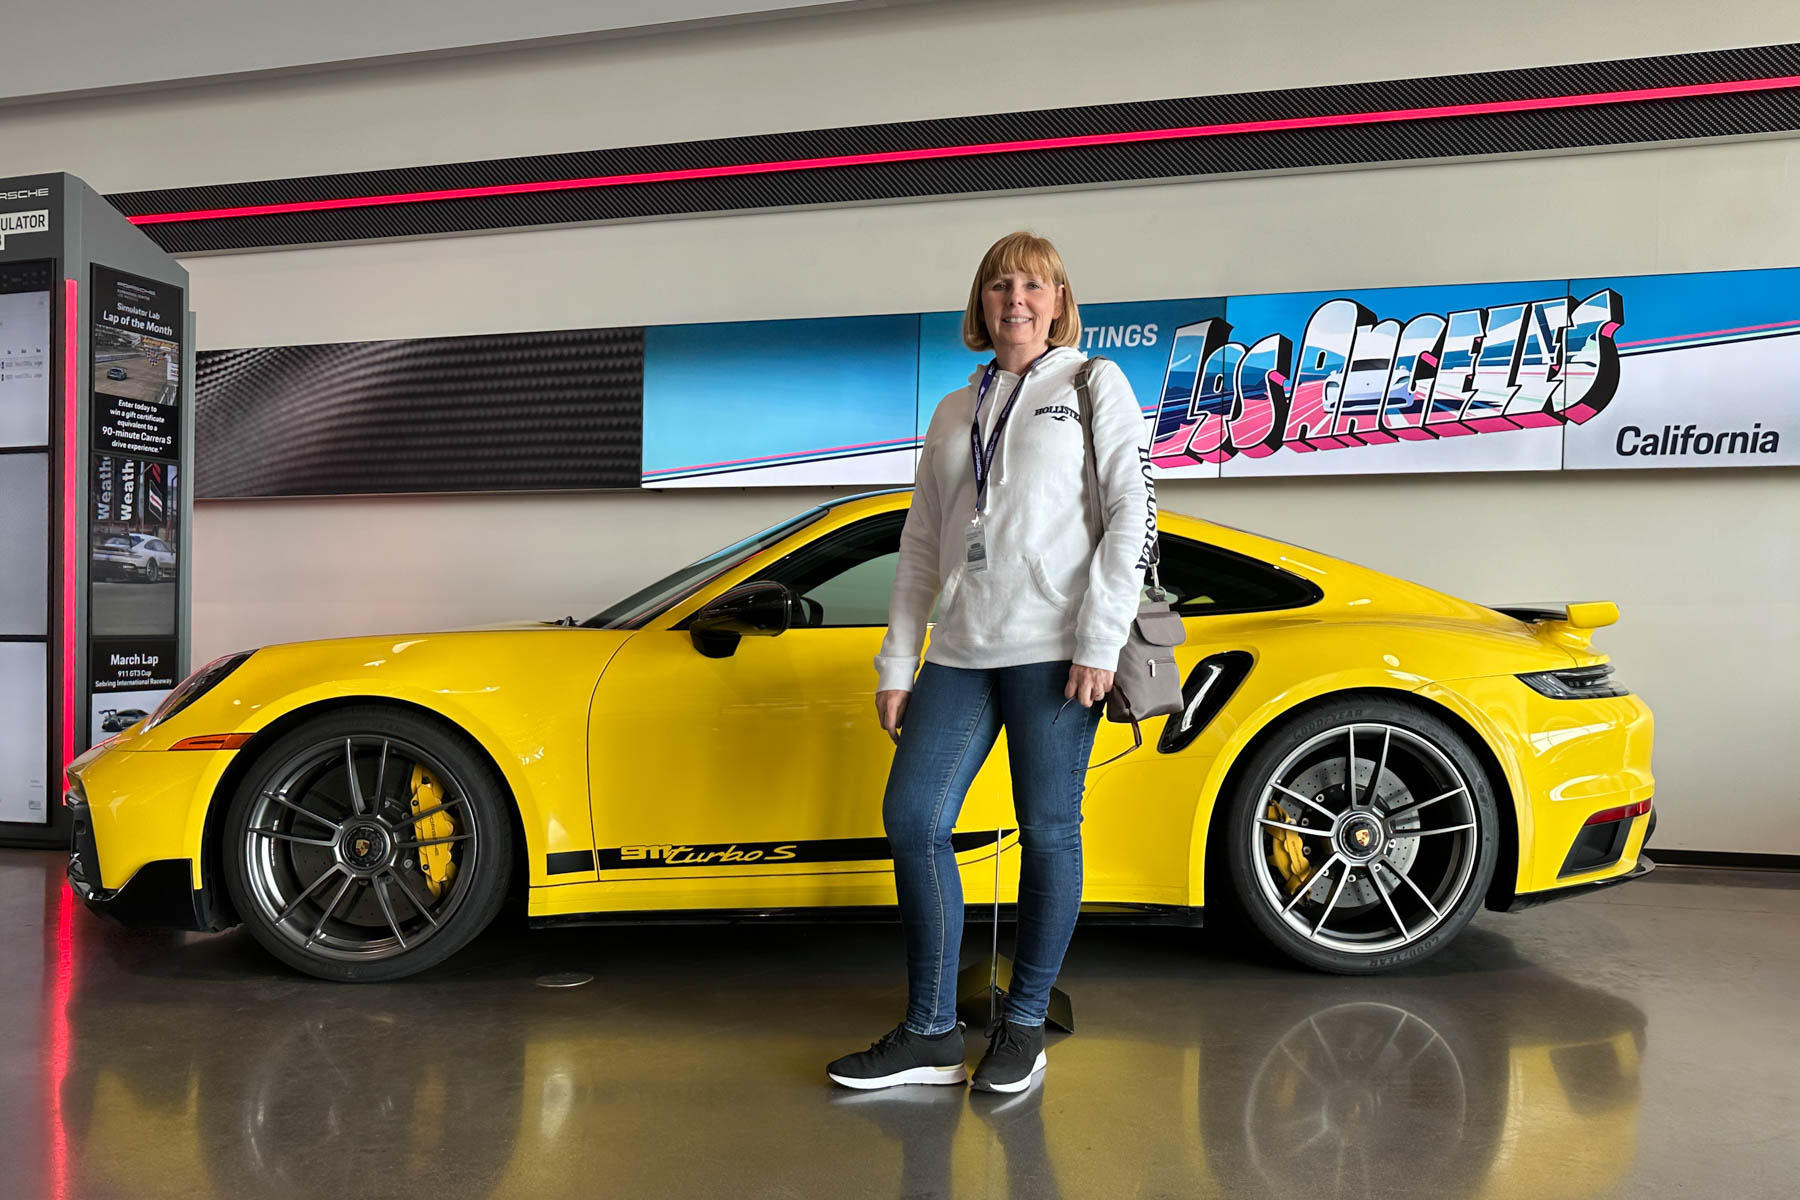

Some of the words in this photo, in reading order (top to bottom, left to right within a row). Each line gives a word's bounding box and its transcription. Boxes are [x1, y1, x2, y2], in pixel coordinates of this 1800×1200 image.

[0, 214, 45, 231] ULATOR
[116, 302, 148, 317] Simulator
[148, 310, 160, 321] Lab
[103, 310, 119, 325] Lap
[120, 316, 132, 325] of
[131, 318, 145, 329] the
[146, 321, 173, 336] Month
[1083, 323, 1159, 349] TINGS
[118, 400, 133, 409] Enter
[134, 402, 151, 412] today
[1033, 405, 1082, 426] HOLLISTE
[110, 409, 121, 417] win
[126, 411, 136, 419] gift
[136, 413, 165, 423] certificate
[117, 420, 147, 430] equivalent
[102, 426, 141, 440] 90-minute
[141, 432, 166, 444] Carrera
[166, 436, 172, 445] S
[112, 440, 127, 449] drive
[1616, 423, 1780, 457] California
[121, 459, 135, 520] Weath
[110, 653, 140, 666] March
[142, 653, 159, 667] Lap
[95, 680, 117, 688] Sebring
[149, 678, 172, 686] Raceway
[620, 843, 673, 861] 911
[665, 845, 764, 864] turbo
[763, 845, 797, 860] S
